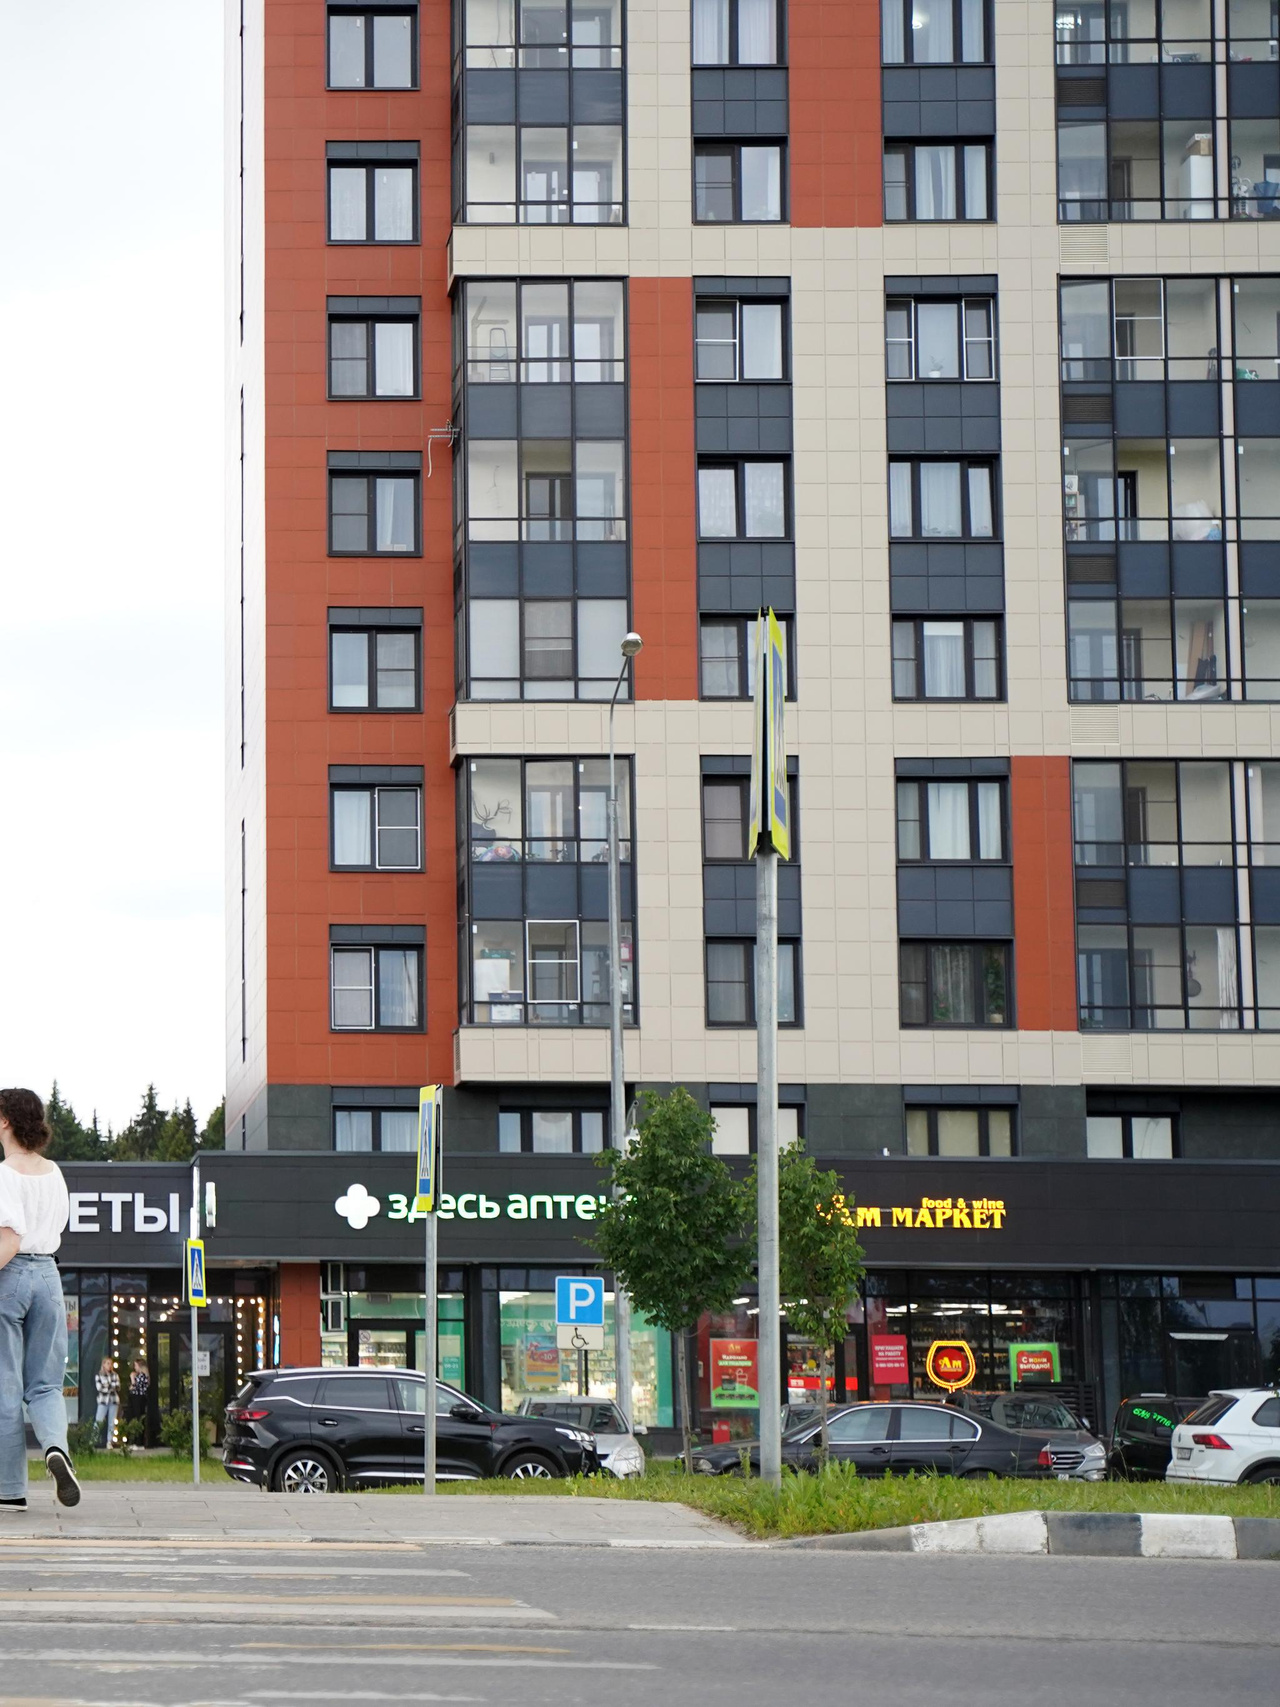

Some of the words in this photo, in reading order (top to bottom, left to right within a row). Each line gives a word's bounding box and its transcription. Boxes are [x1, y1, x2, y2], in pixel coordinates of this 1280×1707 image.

[507, 1192, 637, 1220] апте
[922, 1197, 952, 1209] food
[957, 1198, 966, 1209] &
[972, 1198, 1005, 1209] wine
[892, 1208, 1006, 1229] МАРКЕТ
[570, 1282, 595, 1320] P
